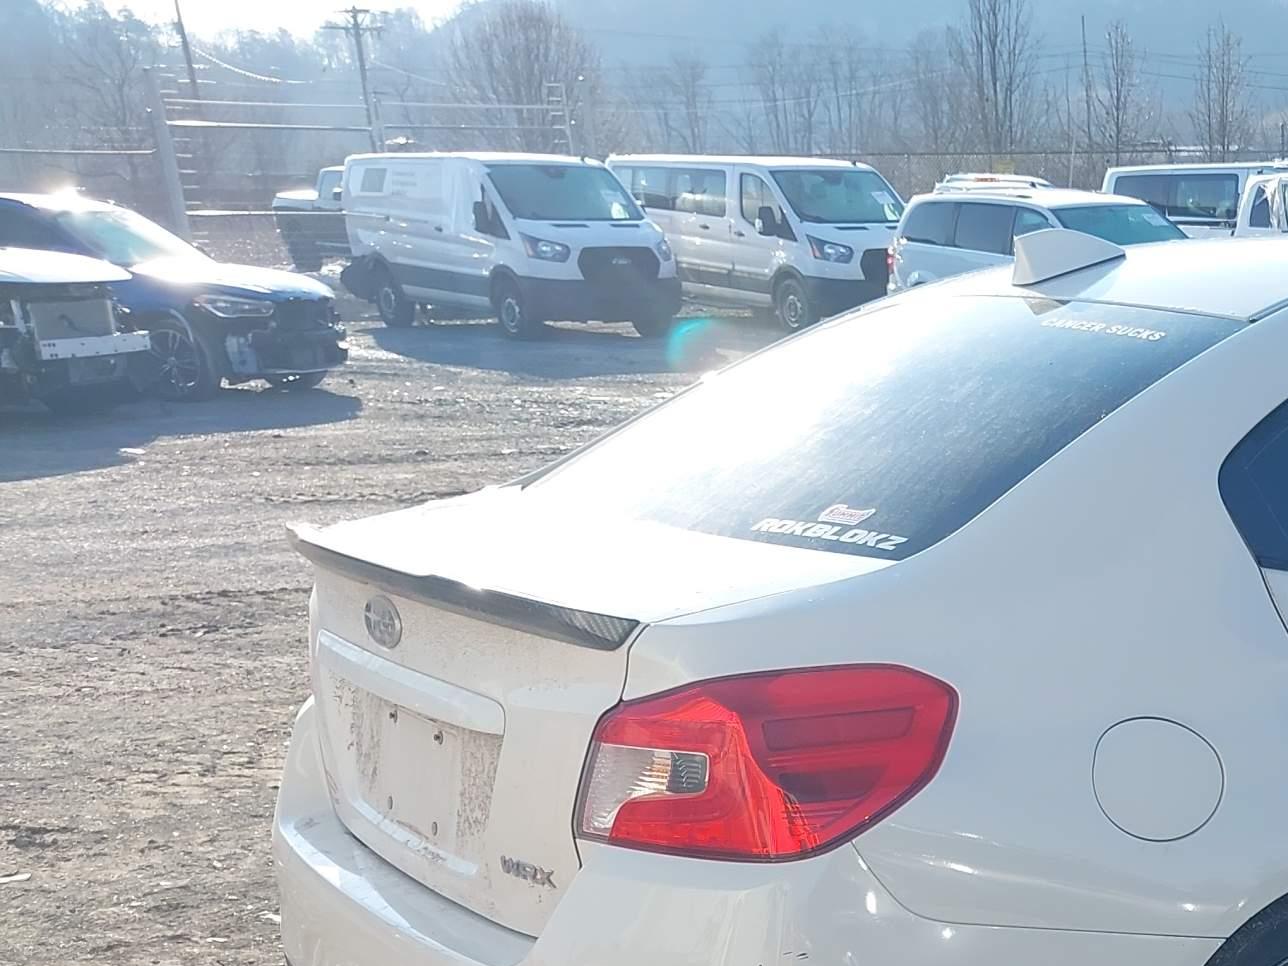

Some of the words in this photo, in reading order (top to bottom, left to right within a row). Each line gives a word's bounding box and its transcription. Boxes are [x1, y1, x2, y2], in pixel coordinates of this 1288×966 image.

[1041, 318, 1106, 332] CANCER
[1105, 325, 1167, 341] SUCKS
[500, 855, 557, 889] WRX
